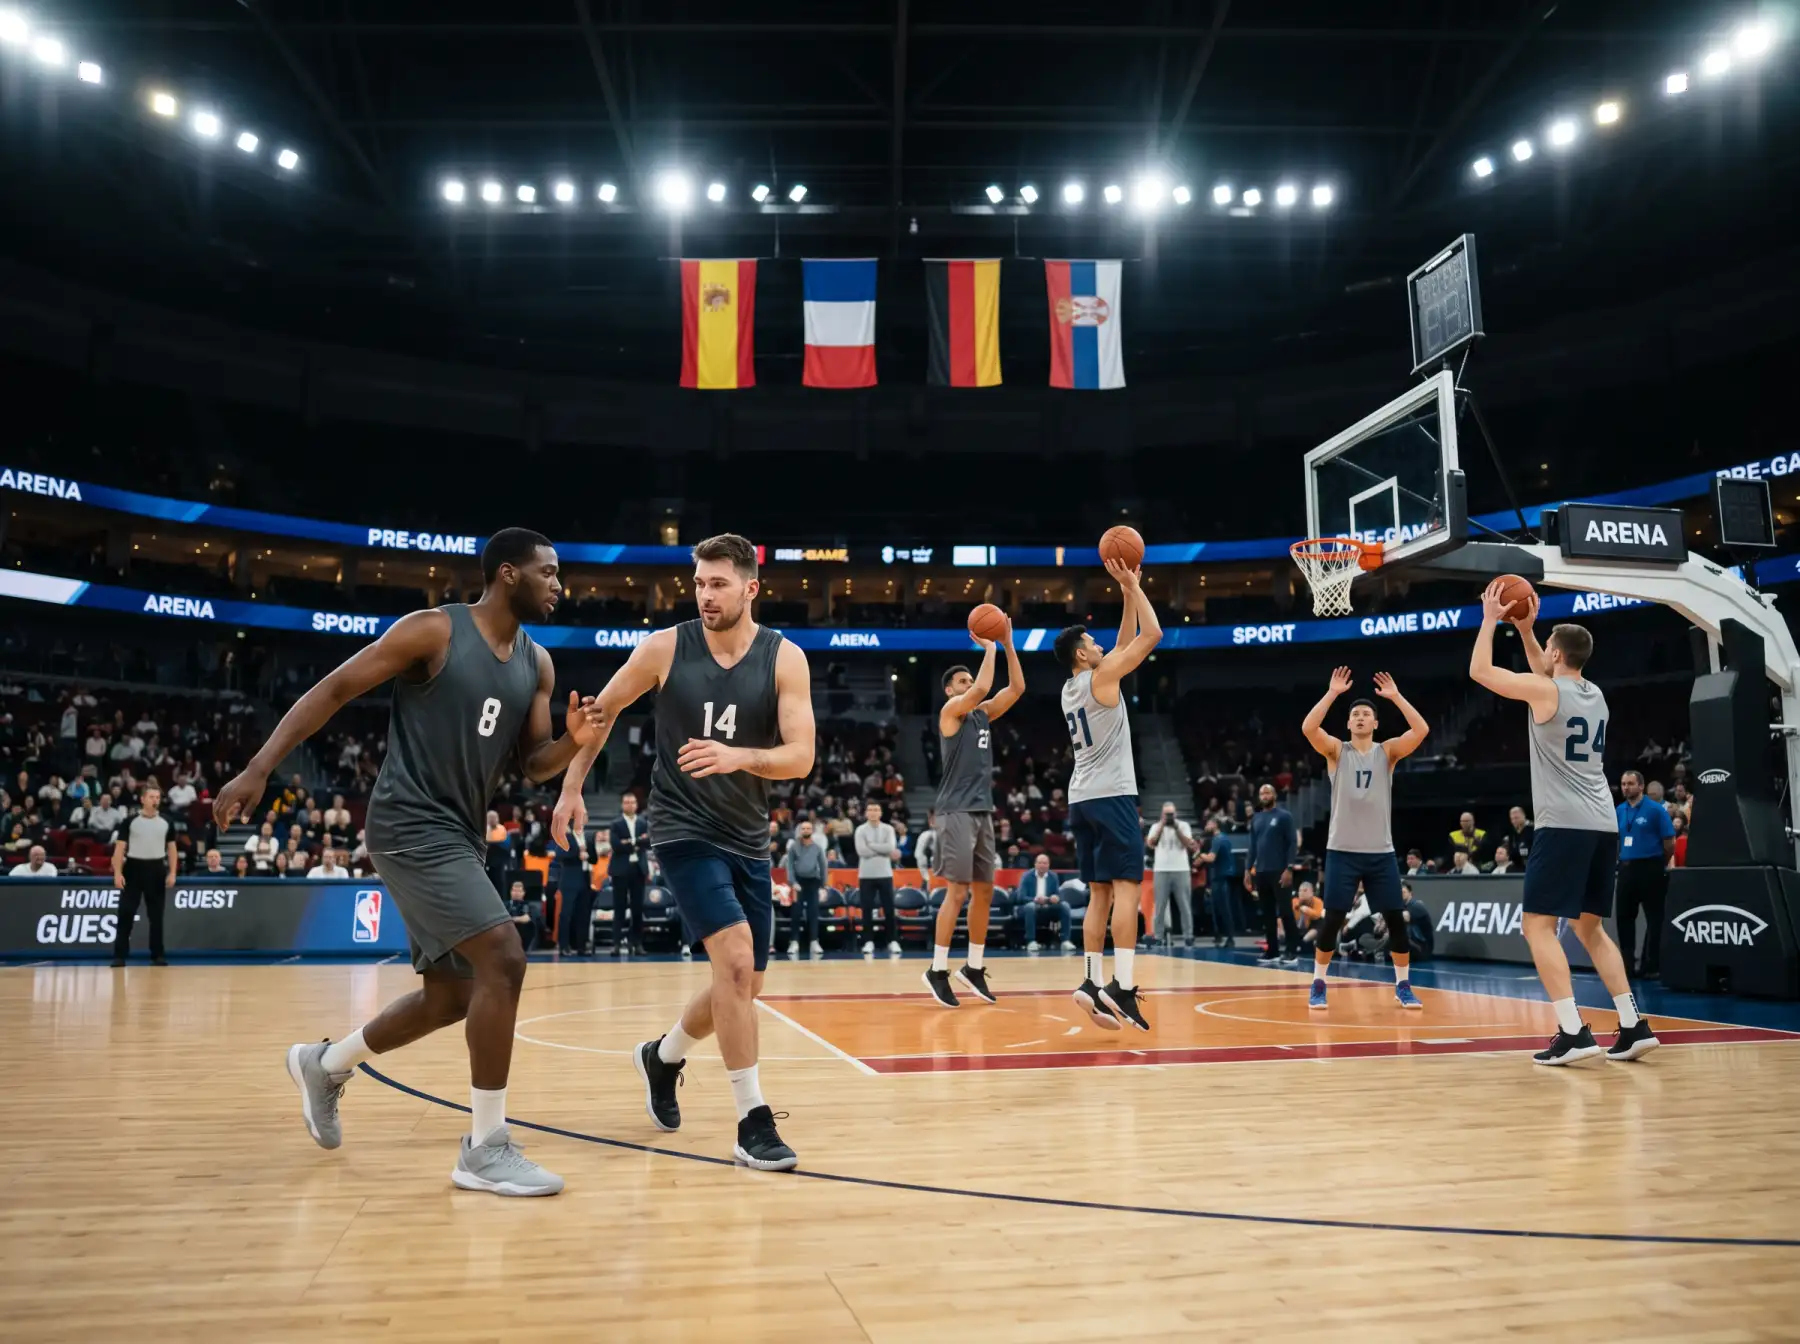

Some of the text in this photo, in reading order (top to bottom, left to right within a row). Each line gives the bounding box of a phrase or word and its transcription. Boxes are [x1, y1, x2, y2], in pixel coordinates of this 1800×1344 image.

[0, 468, 82, 501] ARENA
[367, 528, 477, 555] PRE-GAME
[1335, 522, 1434, 552] PRE-GAM
[1584, 520, 1669, 547] ARENA
[143, 594, 215, 619] ARENA
[312, 612, 380, 635] SPORT
[1232, 623, 1296, 644] SPORT
[1360, 608, 1462, 636] GAME DAY
[829, 633, 880, 647] ARENA
[477, 697, 502, 737] 8
[703, 701, 738, 740] 14
[1066, 707, 1093, 751] 21
[1565, 716, 1605, 762] 24
[1355, 770, 1373, 789] 17
[1701, 773, 1726, 784] ARENA
[60, 889, 121, 909] HOME
[174, 889, 239, 909] GUEST
[36, 914, 140, 944] GUES
[1435, 901, 1525, 936] ARENA
[1683, 920, 1754, 946] ARENA
